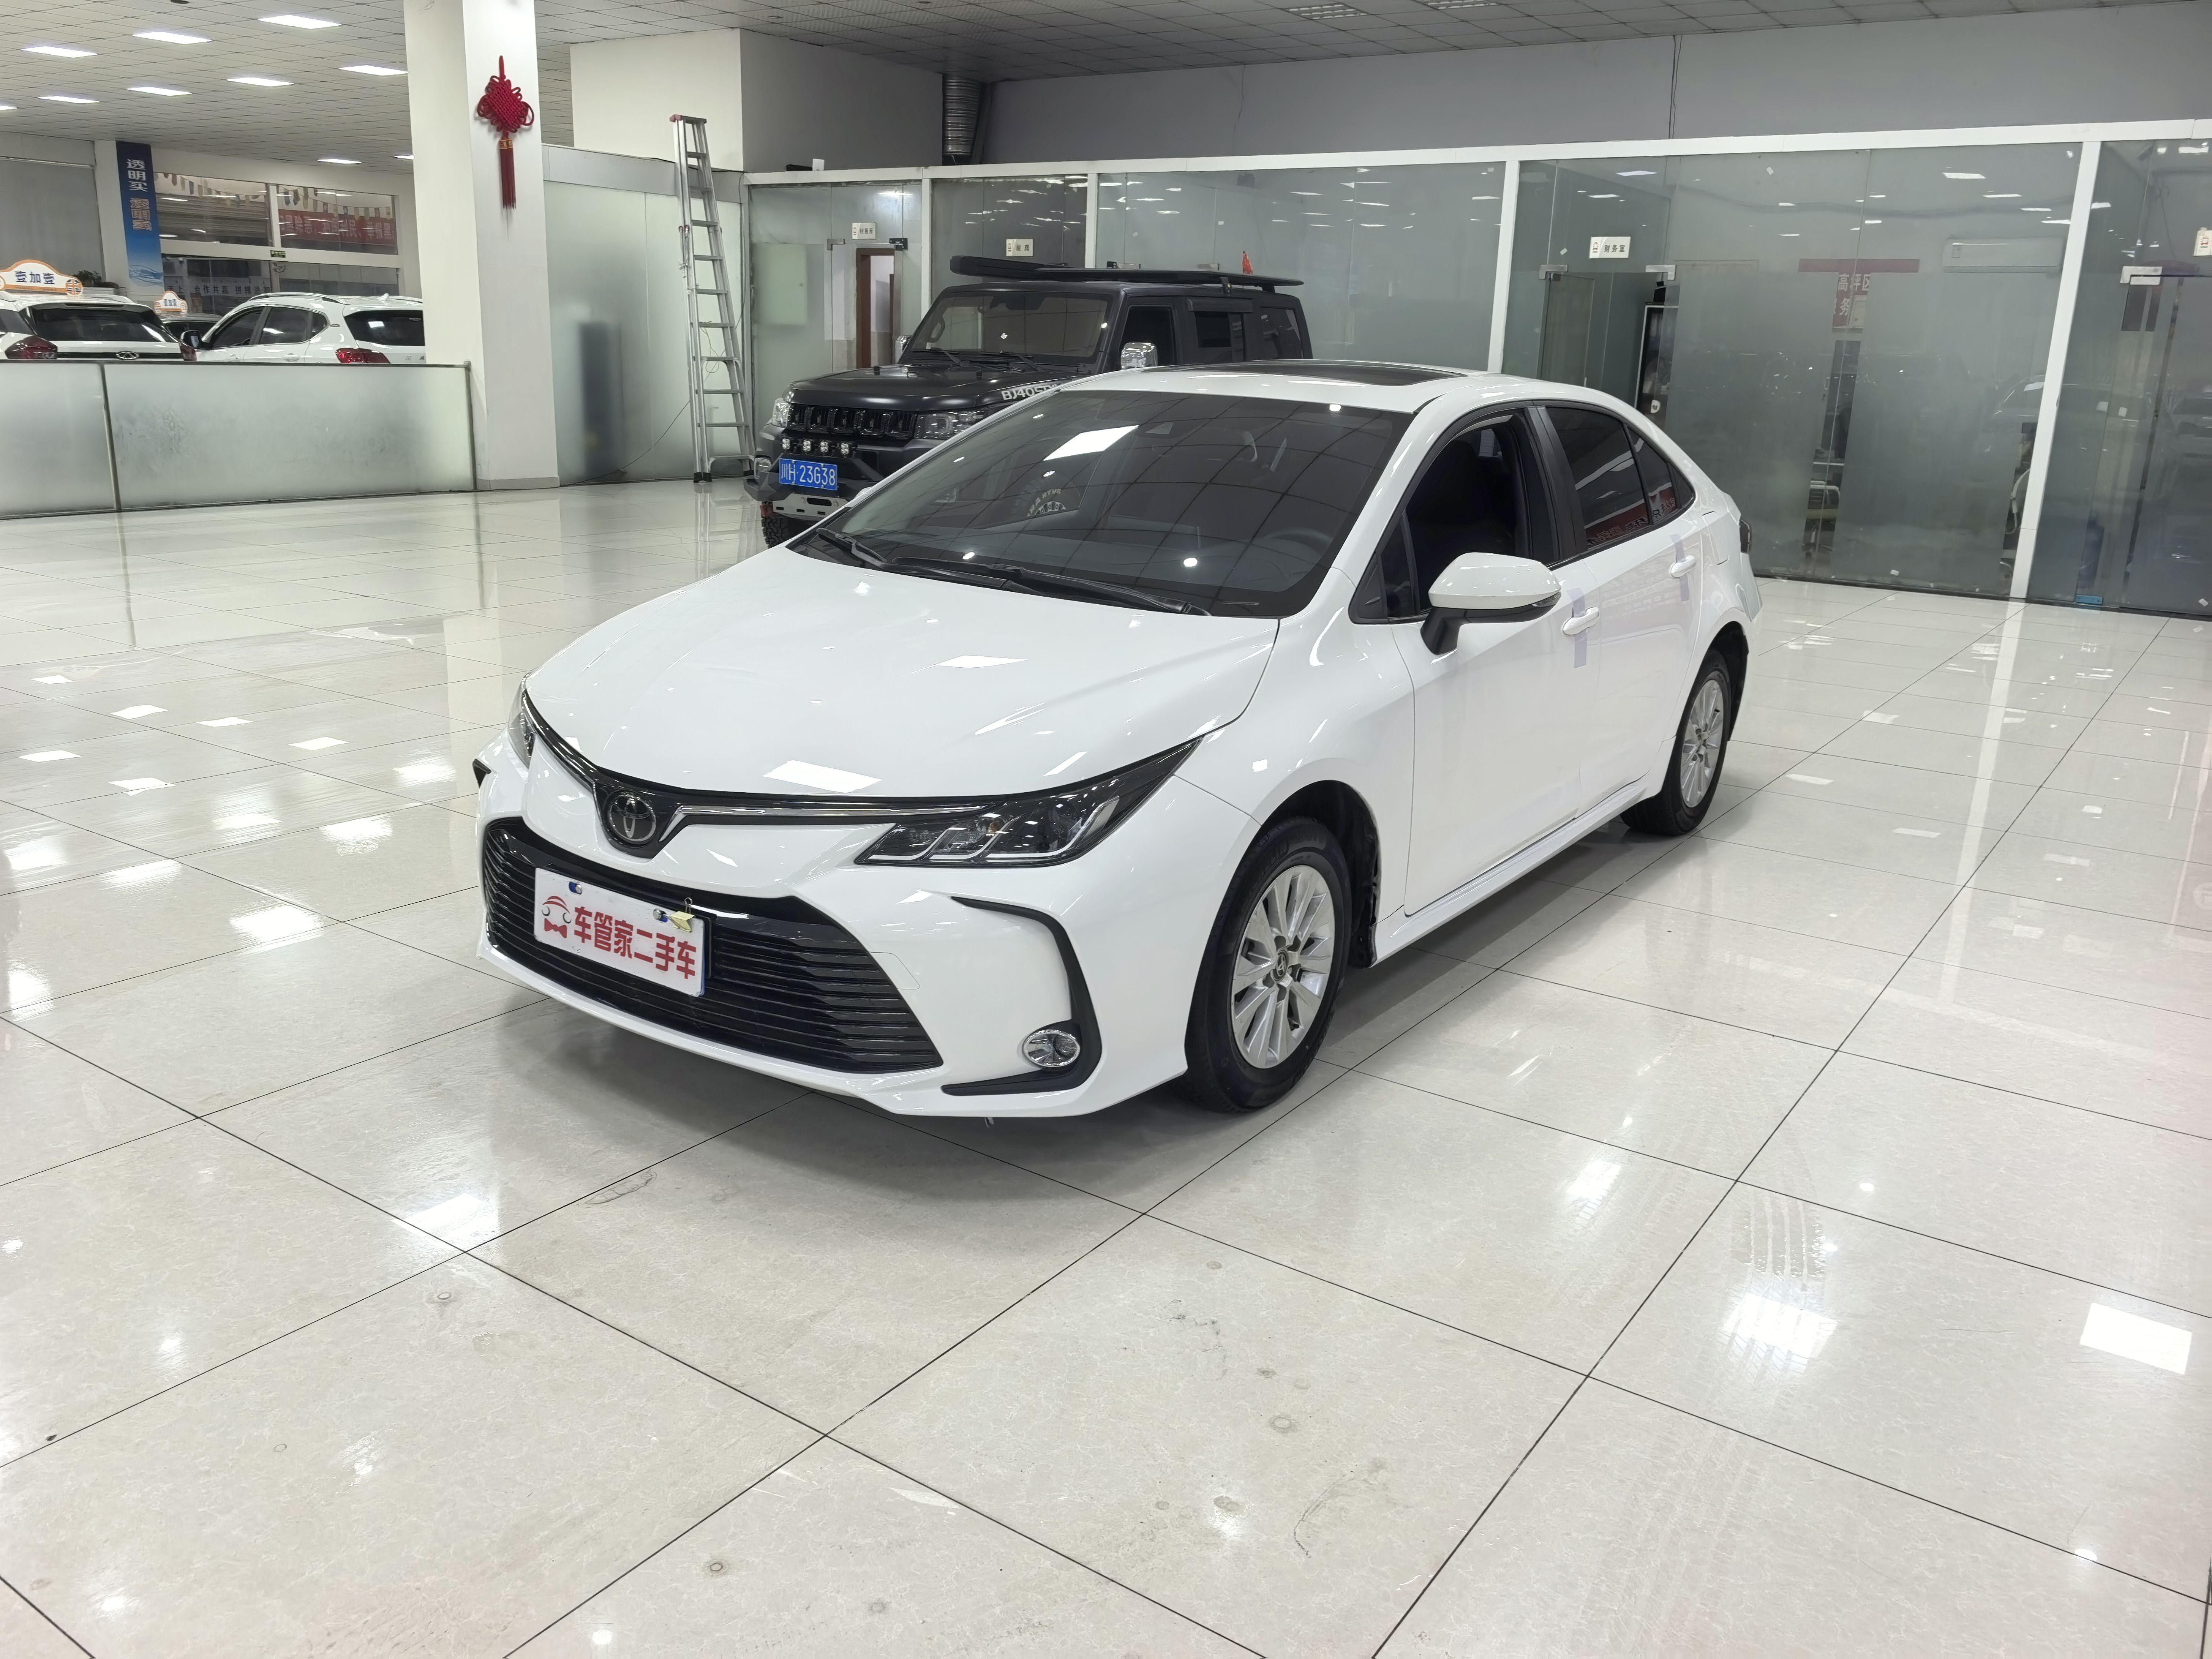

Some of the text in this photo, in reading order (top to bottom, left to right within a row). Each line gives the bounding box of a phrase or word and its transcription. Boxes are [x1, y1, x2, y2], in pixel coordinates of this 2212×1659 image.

[126, 159, 148, 192] 透明买
[1604, 244, 1625, 253] 财务室
[14, 270, 55, 284] 壹加壹
[574, 906, 697, 979] 车管家二手车
